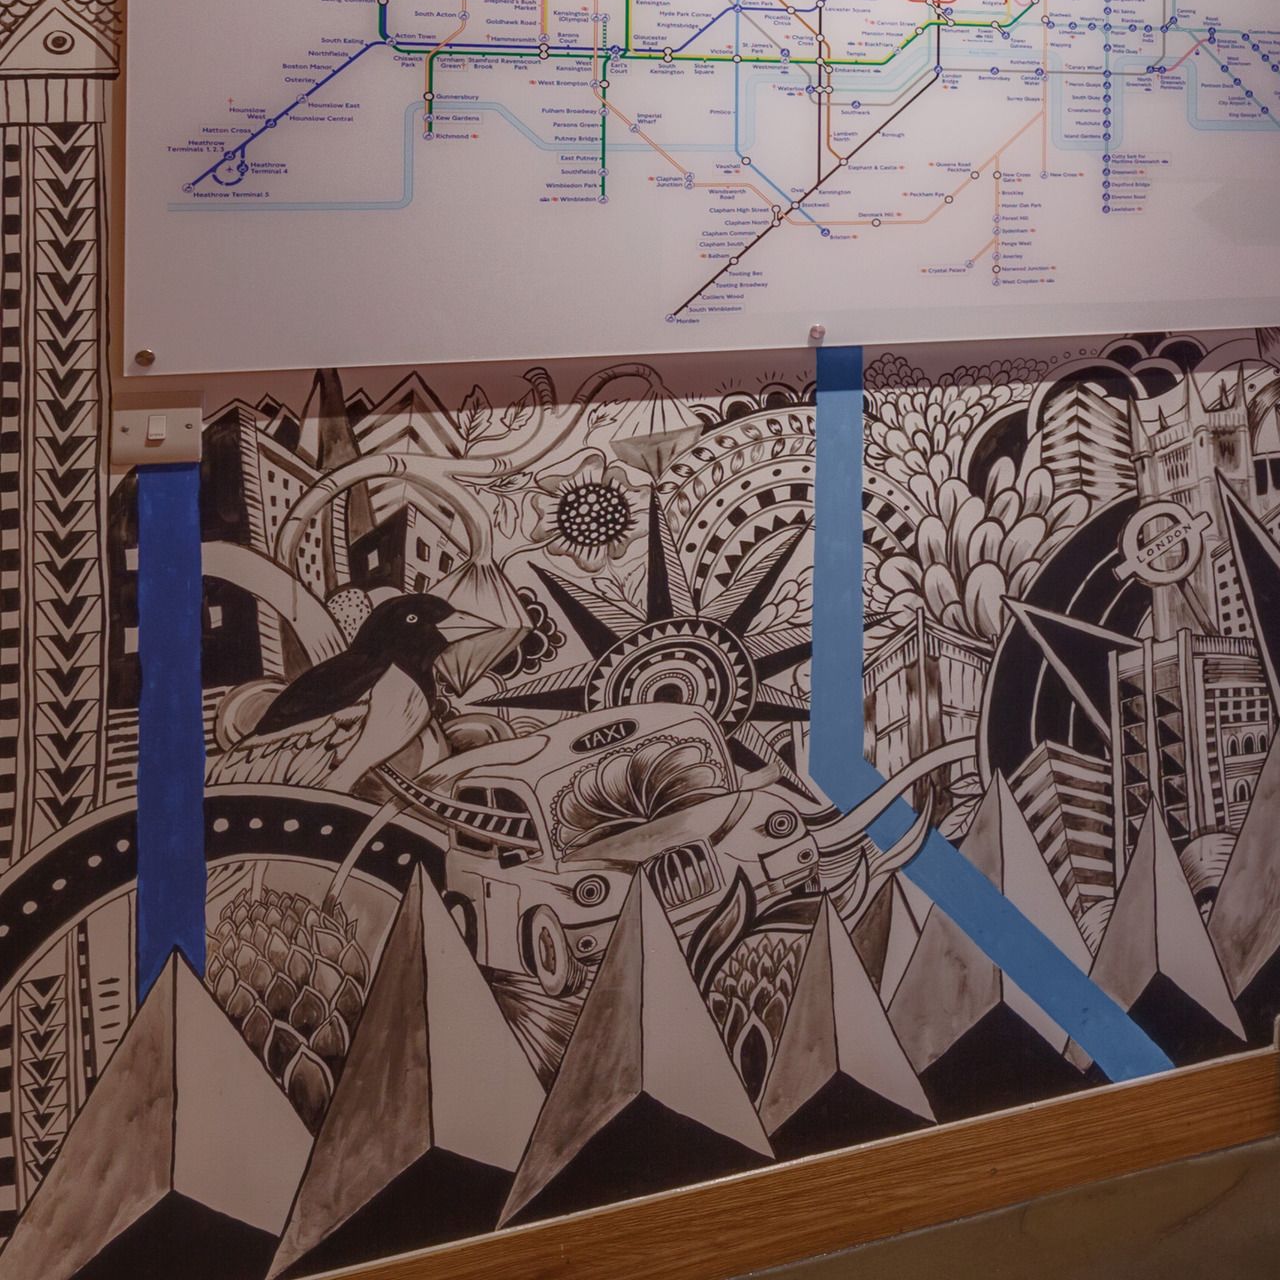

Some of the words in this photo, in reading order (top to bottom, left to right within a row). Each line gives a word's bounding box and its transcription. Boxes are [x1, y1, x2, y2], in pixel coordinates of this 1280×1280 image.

[395, 32, 416, 40] Acton
[342, 38, 364, 46] Ealing
[308, 50, 348, 58] Northfields
[284, 76, 316, 85] Osterley
[538, 80, 554, 88] West
[556, 80, 588, 88] Brompton
[564, 108, 597, 116] Broadway
[202, 126, 228, 134] Hatton
[554, 136, 576, 144] Putney
[578, 136, 598, 144] Bridge
[1137, 524, 1192, 563] LONDON
[581, 724, 627, 749] TAXI
